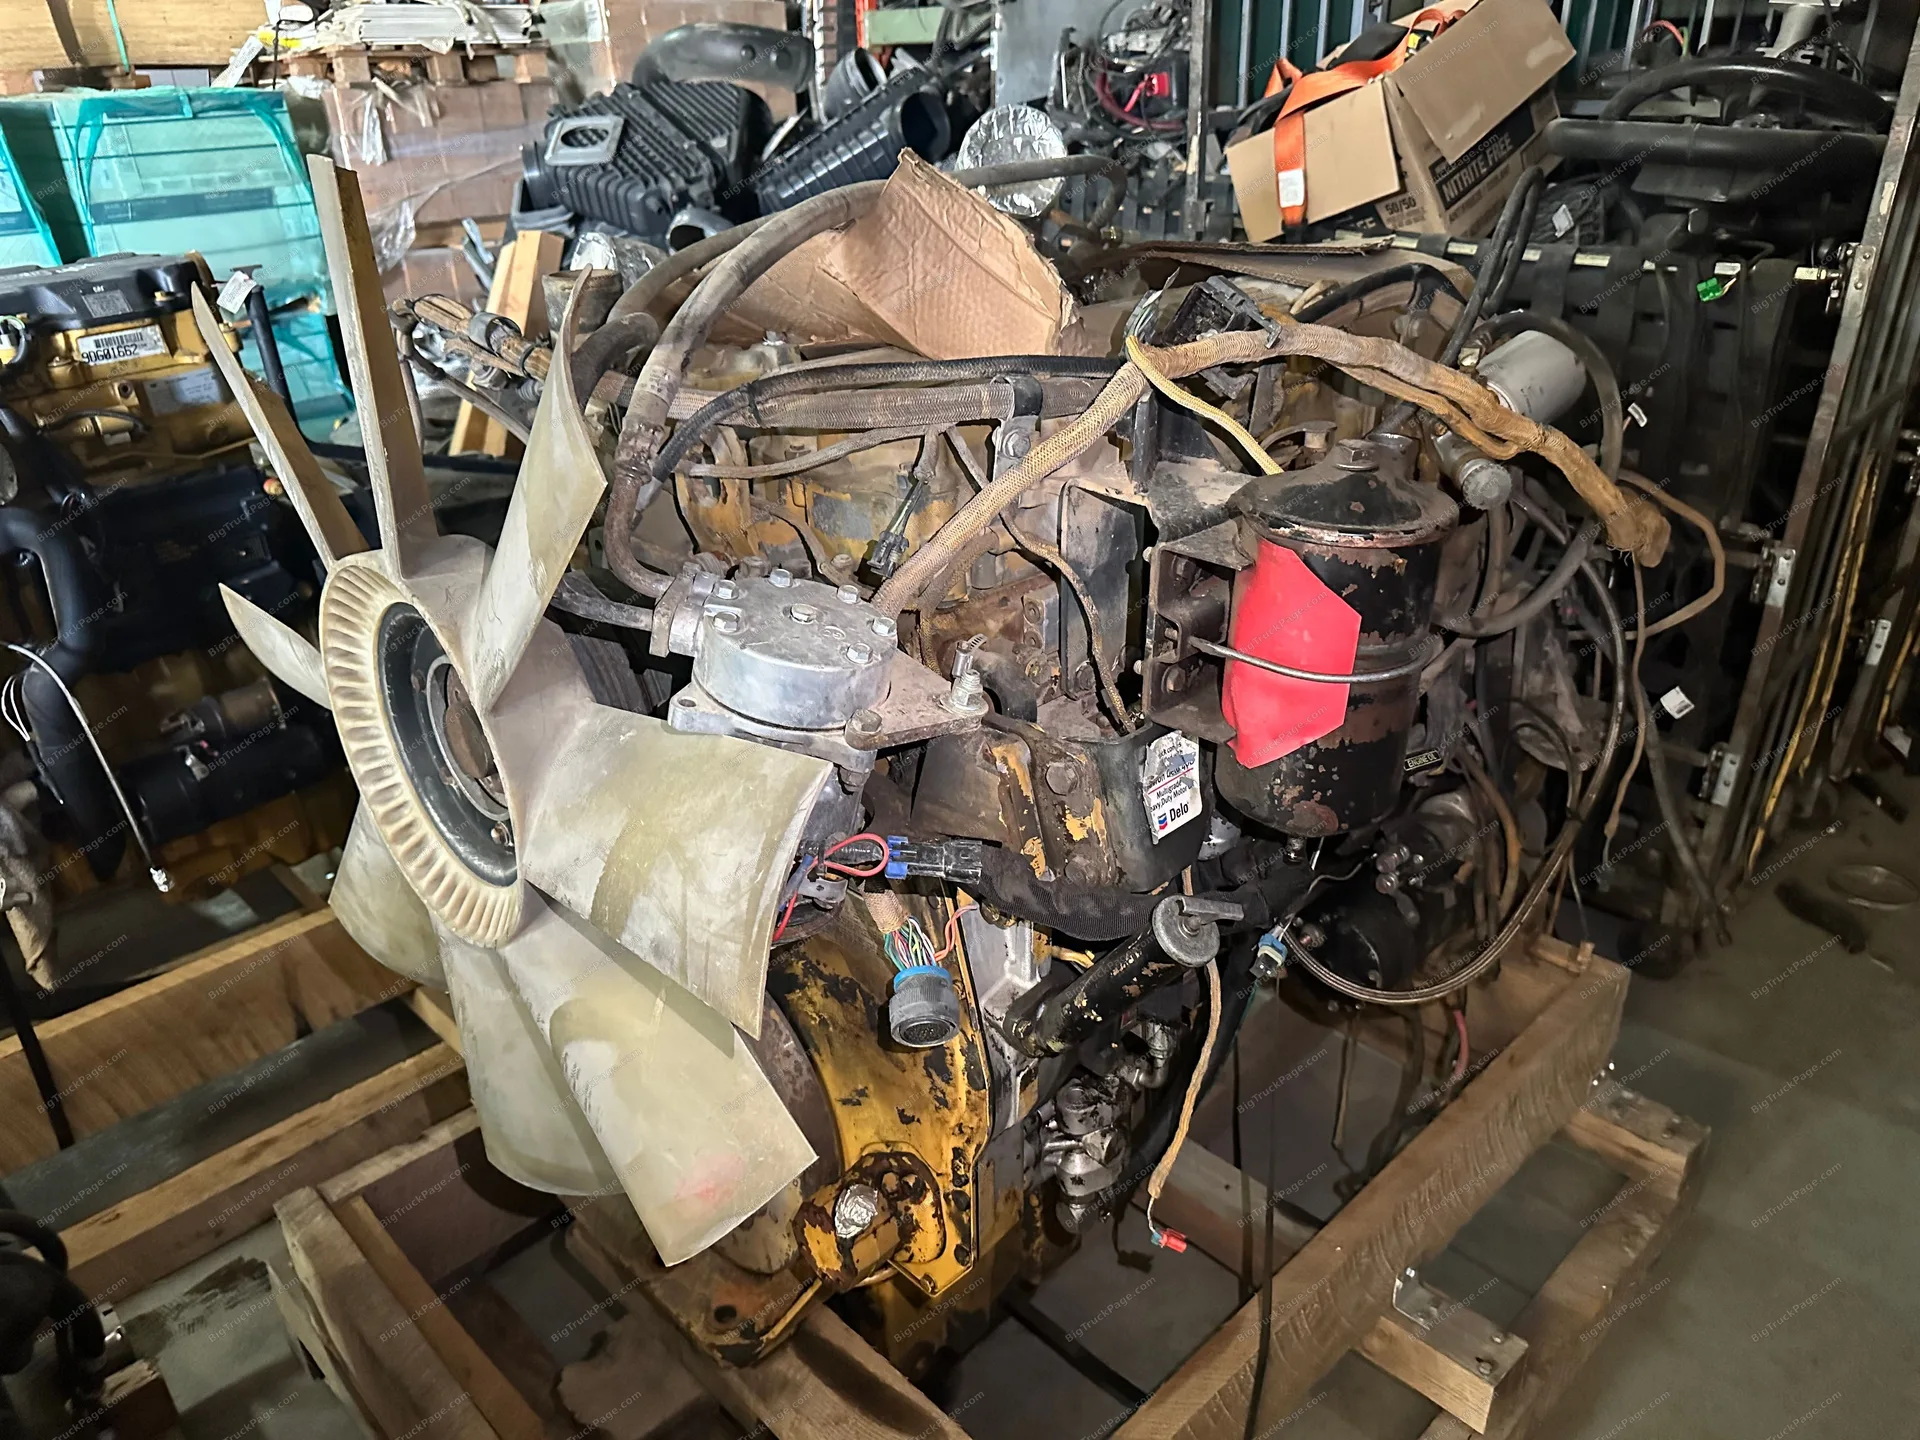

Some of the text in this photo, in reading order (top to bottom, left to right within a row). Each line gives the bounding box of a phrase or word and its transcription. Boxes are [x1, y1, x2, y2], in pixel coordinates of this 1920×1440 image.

[1441, 156, 1487, 202] NITRITE
[1486, 133, 1513, 168] FREE
[1384, 196, 1417, 215] 50/50
[1407, 755, 1429, 768] ENGINE
[1173, 787, 1188, 800] Motor
[1169, 802, 1189, 822] Delo
